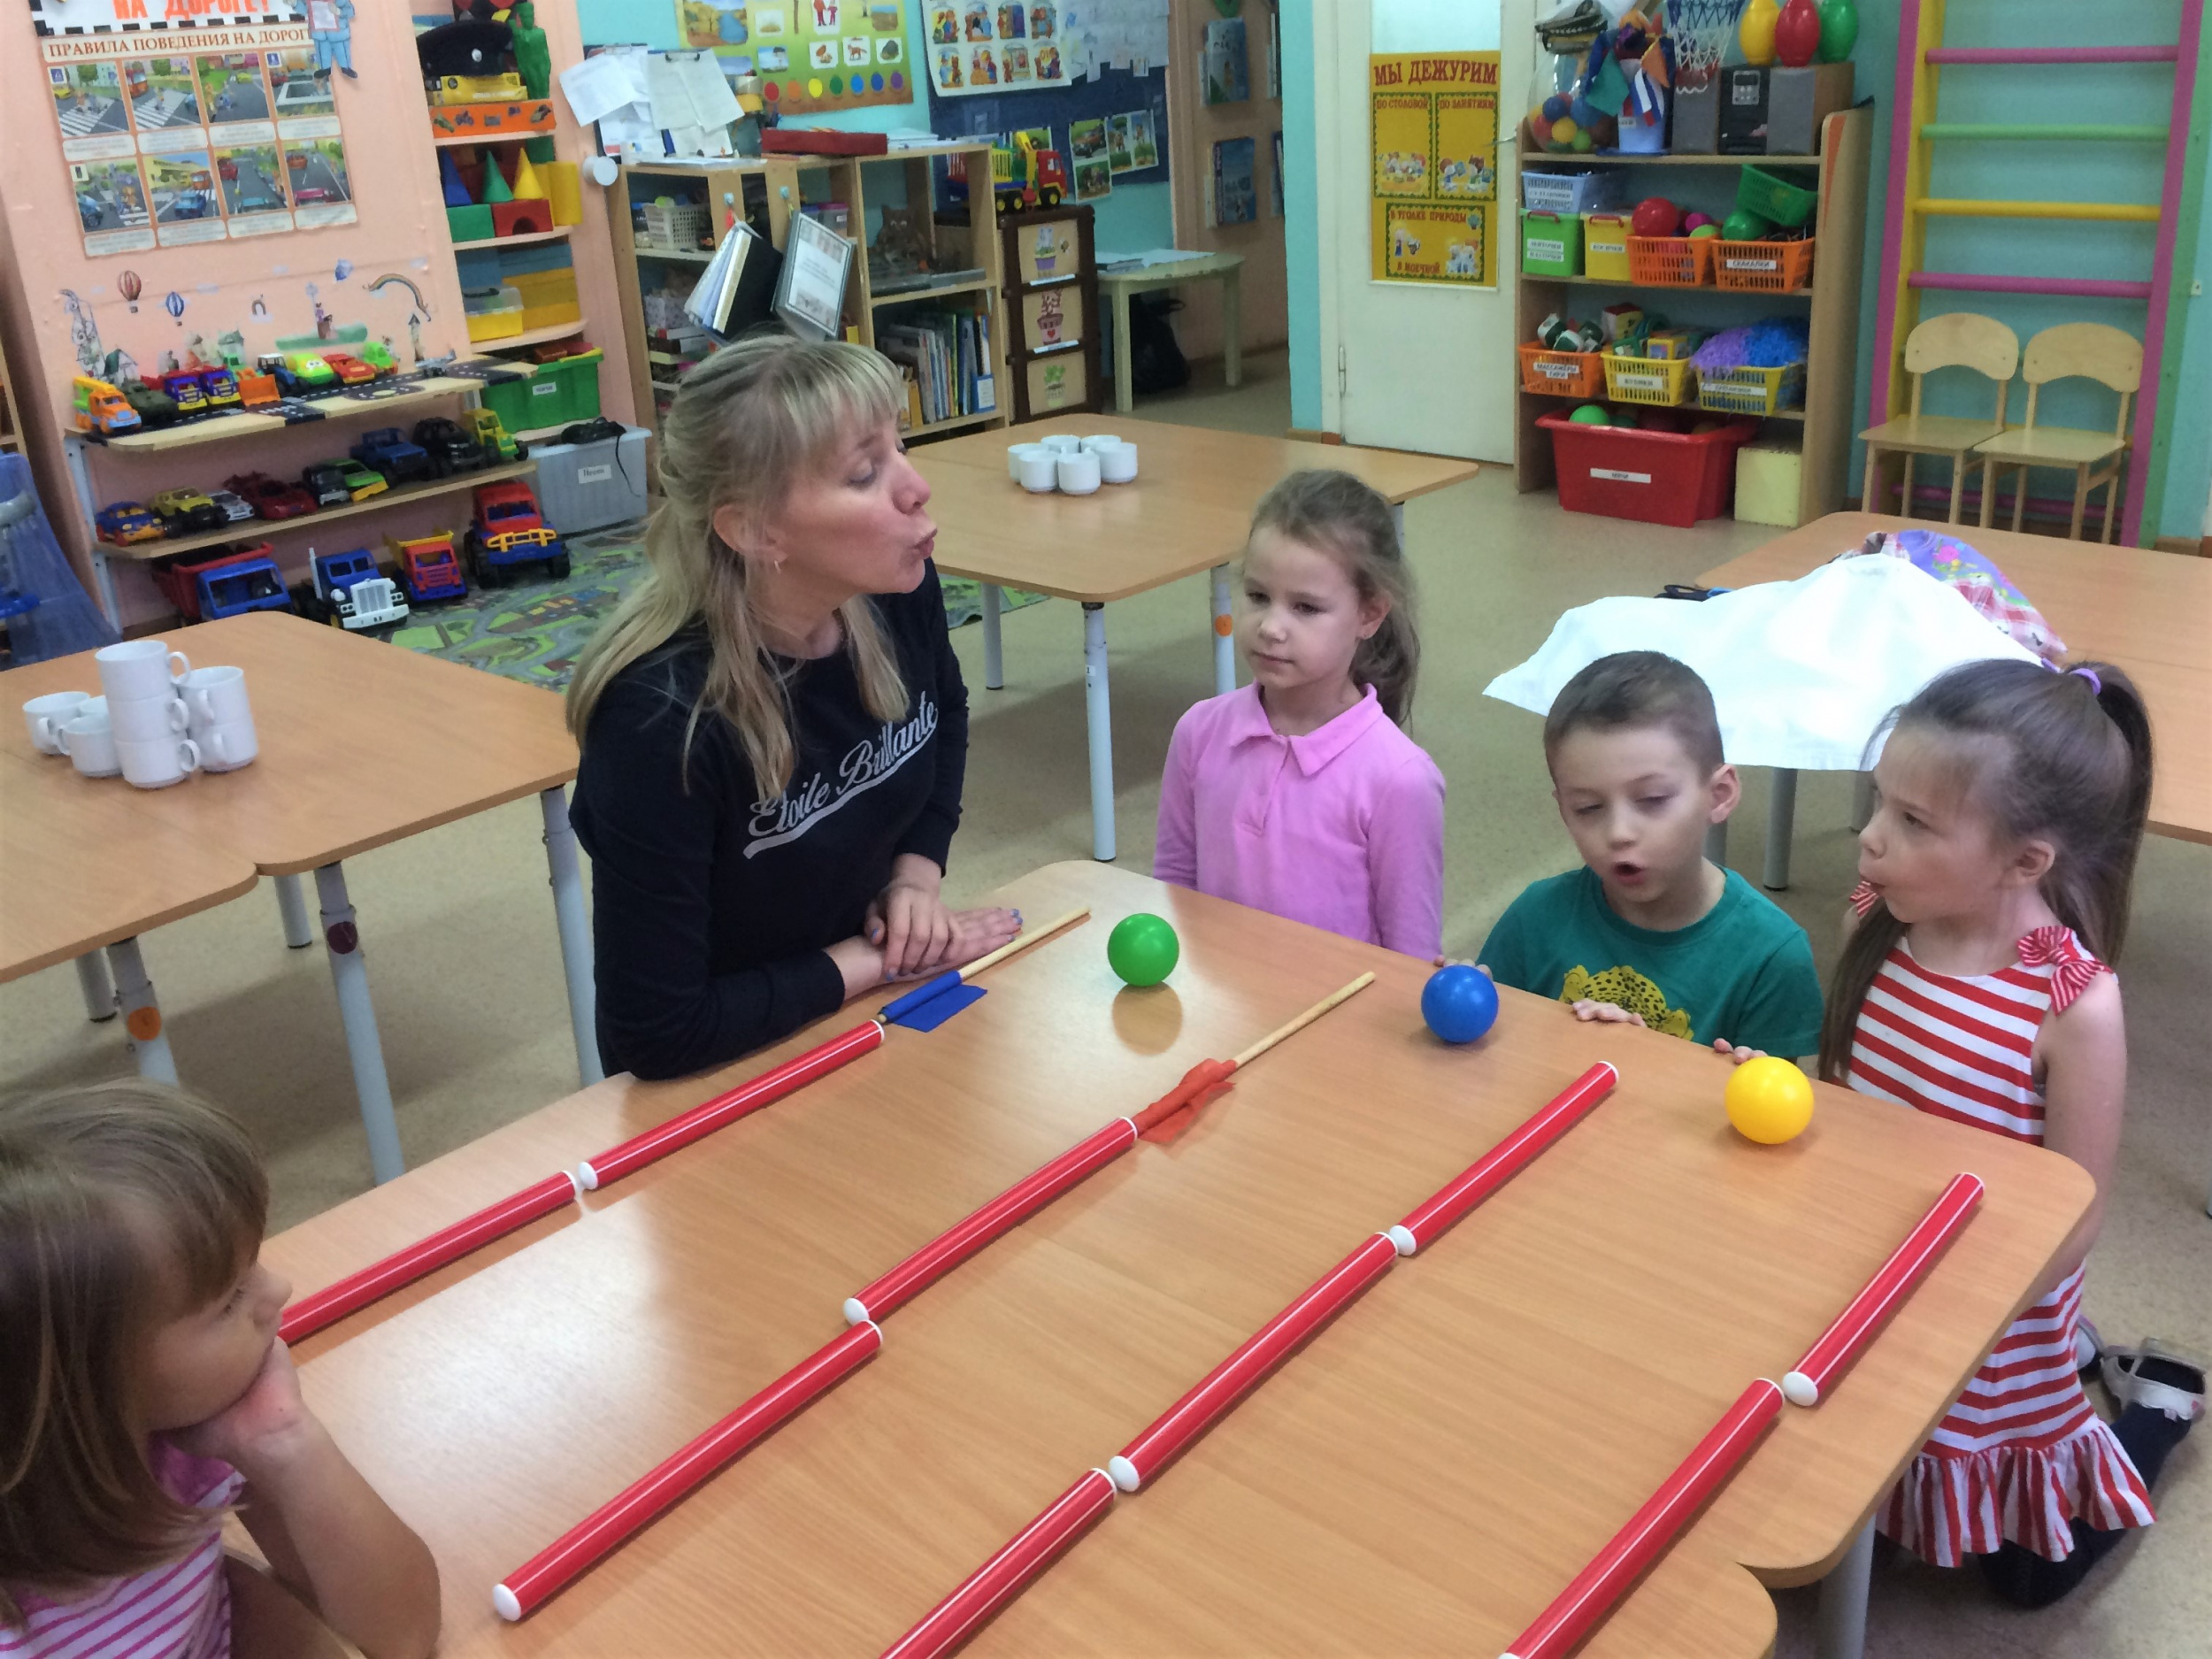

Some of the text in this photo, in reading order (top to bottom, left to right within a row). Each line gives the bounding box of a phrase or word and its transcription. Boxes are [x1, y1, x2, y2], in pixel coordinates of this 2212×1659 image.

[113, 0, 148, 20] НА
[49, 28, 308, 57] ПРАВИЛА ПОВЕДЕНИЯ НА ДОРОГ
[1373, 59, 1498, 86] МЫ ДЕЖУРИМ
[1388, 96, 1428, 110] СТОЛОВОЙ
[1397, 211, 1426, 220] УГОЛКЕ
[1429, 211, 1466, 223] ПРИРОДЫ
[836, 690, 938, 796] Brillante
